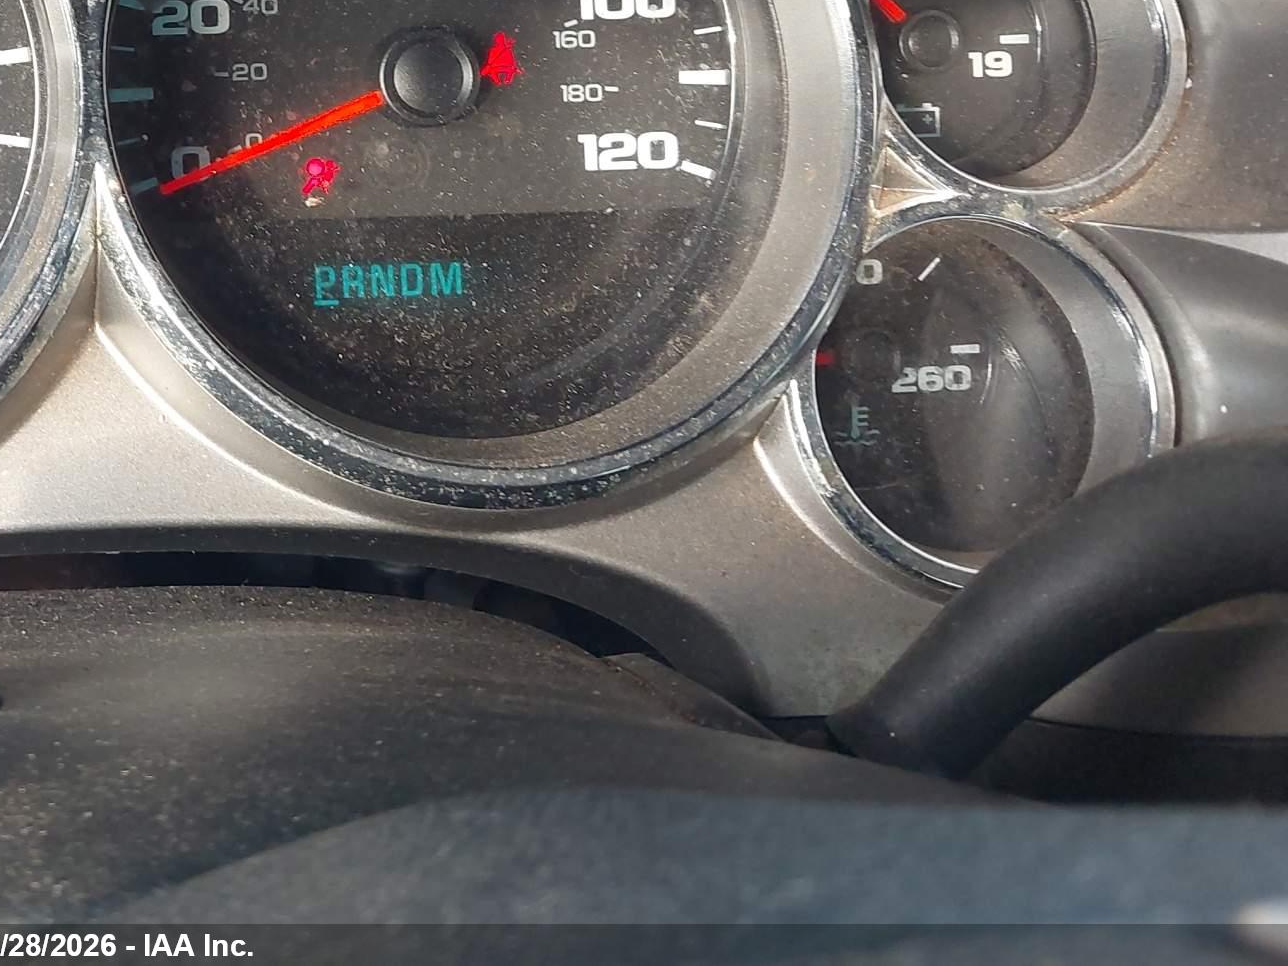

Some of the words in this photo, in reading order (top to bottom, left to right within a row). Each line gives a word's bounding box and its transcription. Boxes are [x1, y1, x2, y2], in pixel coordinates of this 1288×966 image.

[153, 0, 230, 35] 20
[553, 30, 595, 48] 160
[233, 63, 267, 80] 20
[968, 51, 1012, 77] 19
[560, 84, 603, 102] 180
[578, 132, 679, 171] 120
[892, 365, 971, 392] 260
